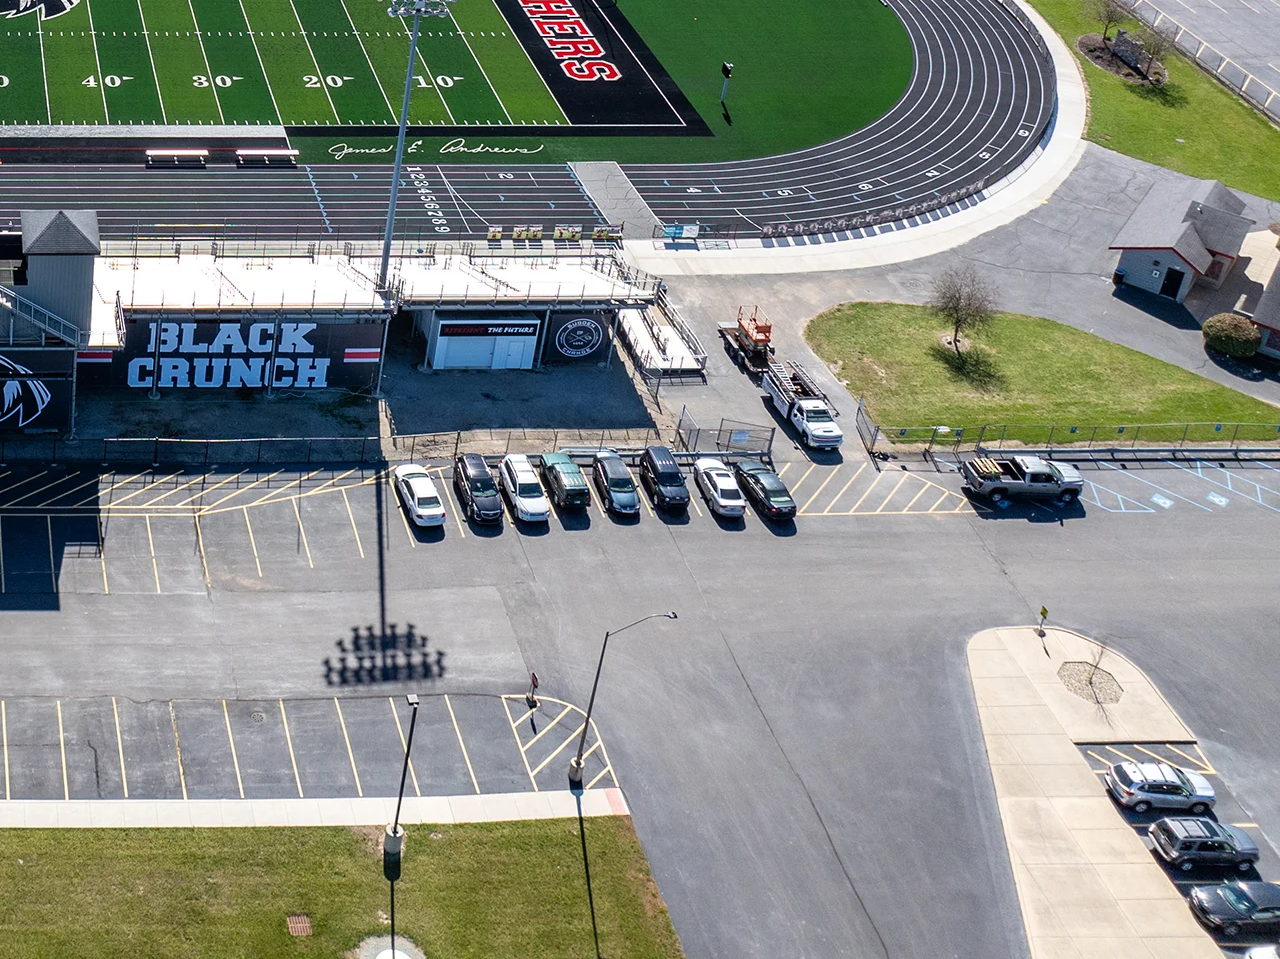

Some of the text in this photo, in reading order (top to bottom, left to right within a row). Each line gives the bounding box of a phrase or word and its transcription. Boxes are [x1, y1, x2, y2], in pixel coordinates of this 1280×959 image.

[81, 74, 120, 88] 40
[193, 74, 233, 88] 30
[303, 74, 343, 88] 20
[413, 74, 453, 88] 10
[1017, 129, 1030, 137] 9
[328, 143, 393, 160] James
[439, 138, 544, 154] Andrews
[147, 323, 317, 353] BLACK
[127, 357, 330, 388] CRUNCH
